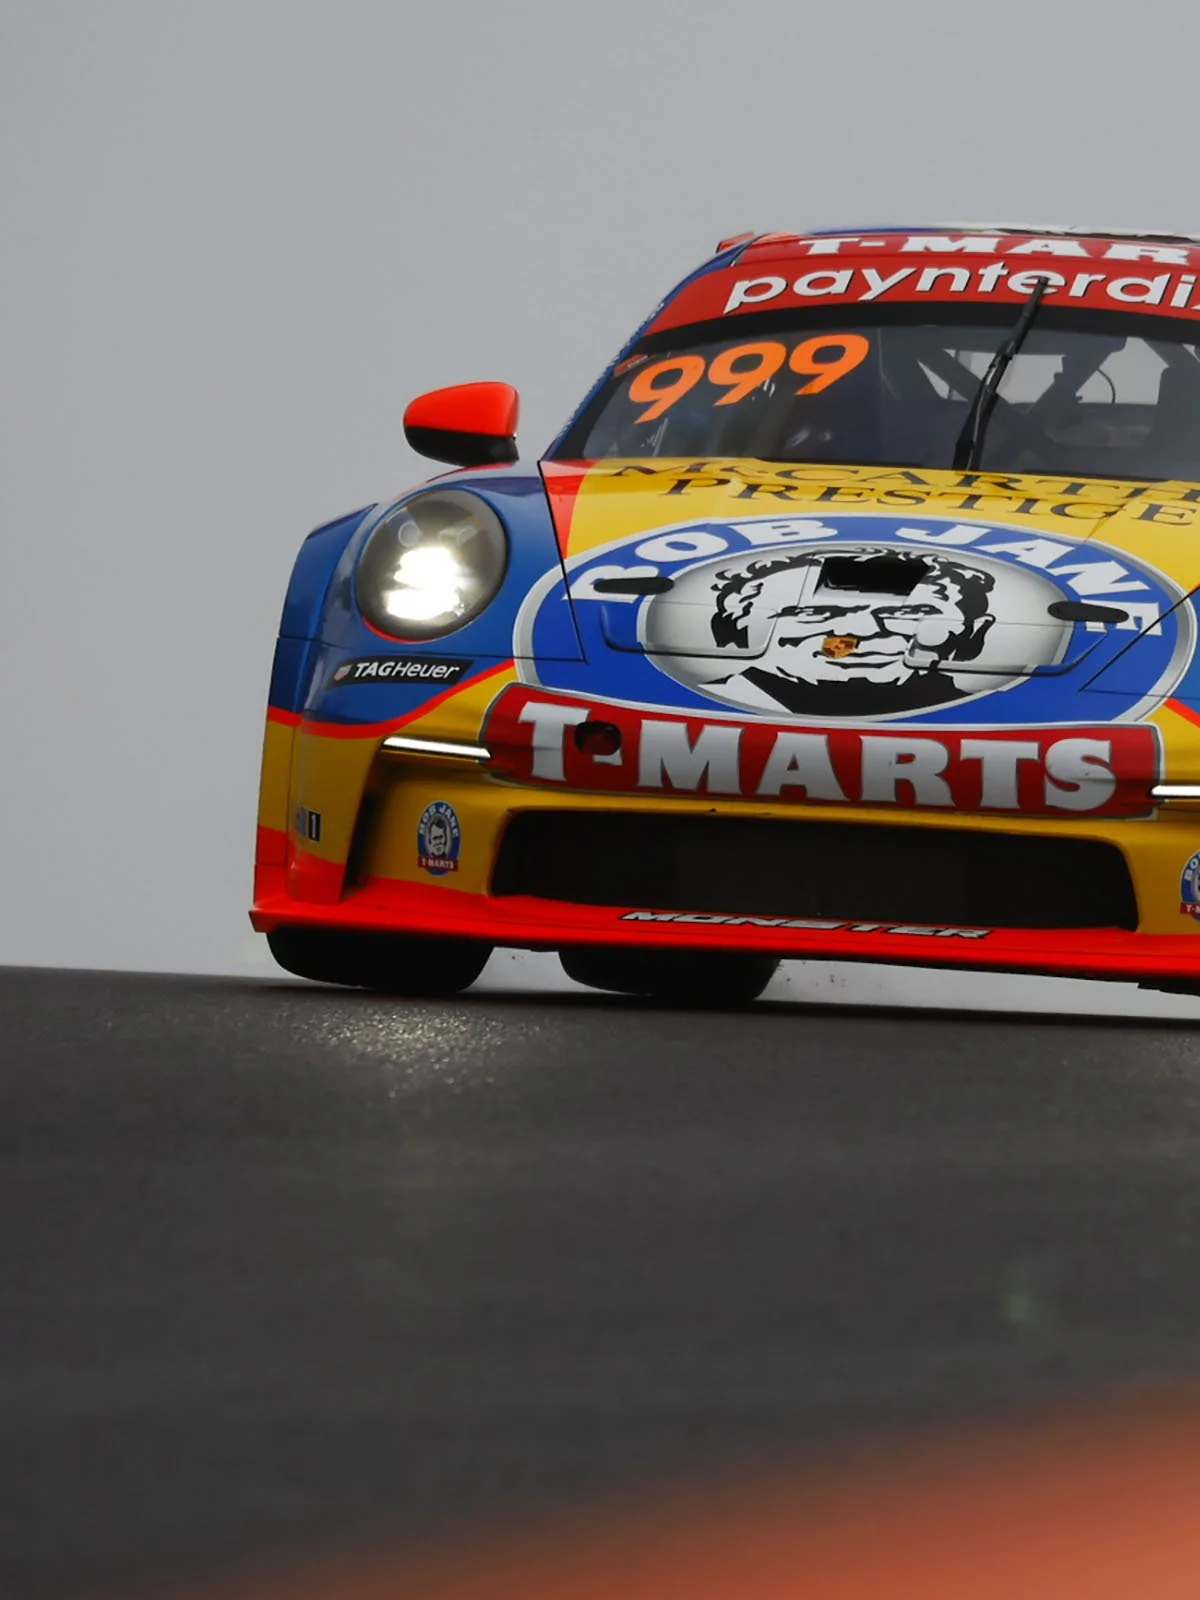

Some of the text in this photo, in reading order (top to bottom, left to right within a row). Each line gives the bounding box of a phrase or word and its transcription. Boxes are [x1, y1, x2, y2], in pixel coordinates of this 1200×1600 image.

[628, 334, 870, 425] 999
[657, 477, 1197, 526] PRESTIGE
[620, 911, 992, 939] MONSTER
